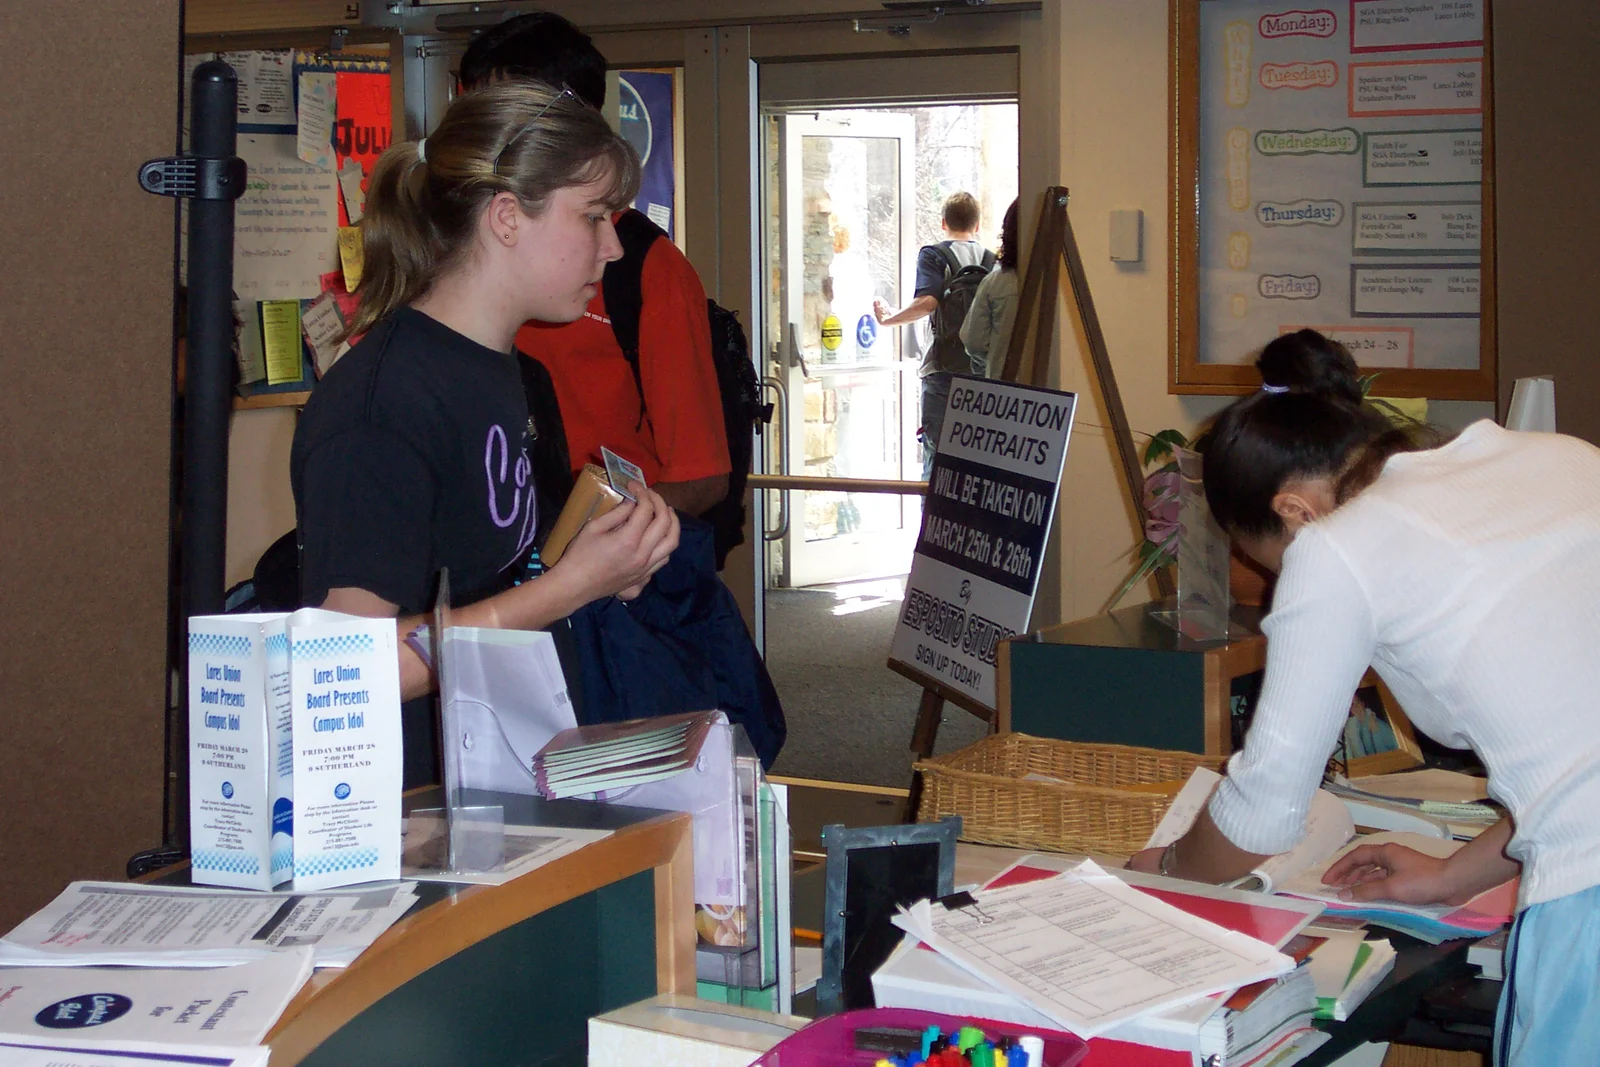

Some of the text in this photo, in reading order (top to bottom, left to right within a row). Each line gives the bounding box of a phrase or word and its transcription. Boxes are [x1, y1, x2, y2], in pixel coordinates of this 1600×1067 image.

[1266, 15, 1330, 34] Monday:
[1265, 67, 1330, 83] Tuesday:
[1262, 133, 1351, 150] Wednesday:
[1262, 204, 1336, 220] Thursday:
[1264, 279, 1316, 296] Friday:
[1364, 339, 1376, 349] 24
[1386, 340, 1399, 350] 28
[950, 387, 1068, 431] GRADUATION
[949, 422, 1049, 465] PORTRAITS
[934, 466, 1046, 526] WILL BE TAKEN ON
[924, 514, 1032, 579] MARCH 25th & 26th
[959, 579, 972, 605] By
[902, 587, 1017, 668] ESPOSITO STUD
[206, 663, 240, 682] Lares Union
[314, 665, 360, 685] Lares Union
[916, 644, 982, 691] SIGN UP TODAY!
[201, 686, 245, 708] Board Presents
[306, 690, 369, 710] Board Presents
[204, 711, 240, 731] Campus Idol
[314, 712, 364, 732] Campus Idol
[302, 747, 333, 756] FRIDAY
[335, 744, 364, 752] MARCH
[207, 760, 246, 770] SUTHERLAND
[315, 760, 371, 771] SUTHERLAND
[150, 1006, 173, 1018] for
[174, 1000, 212, 1024] Packet
[200, 990, 249, 1030] Contestant
